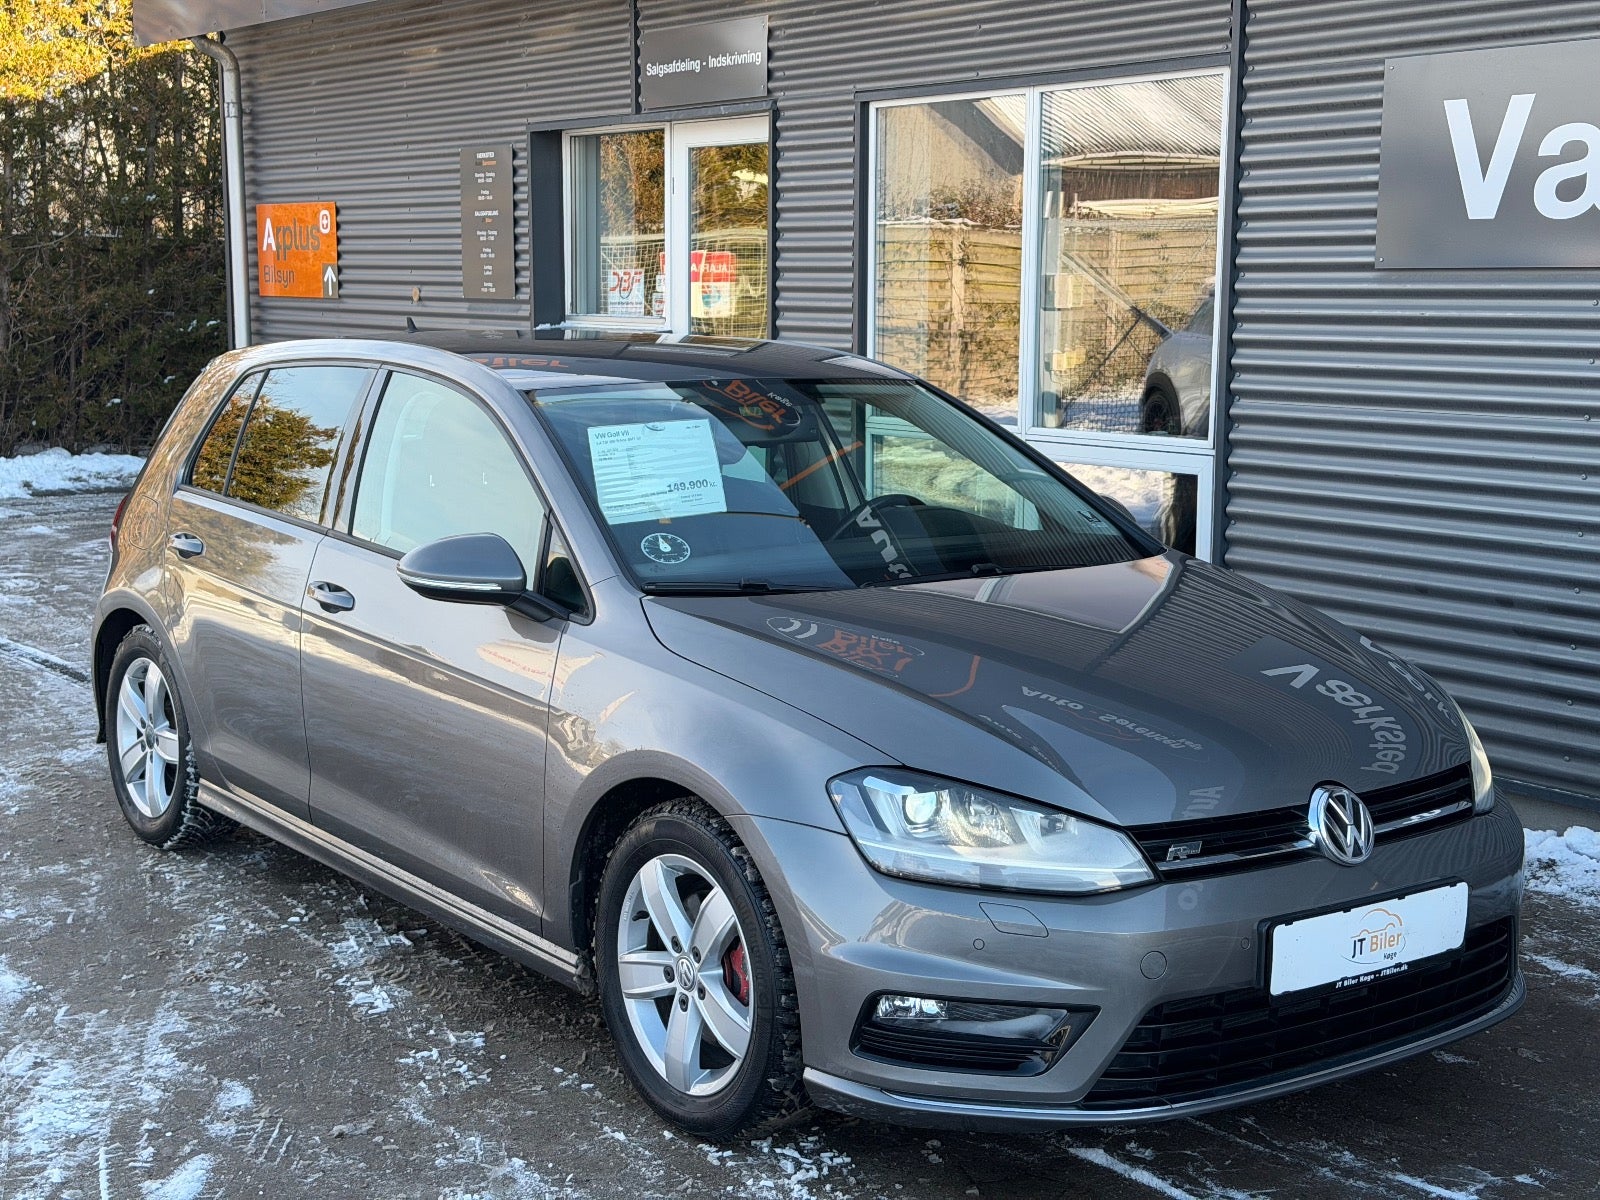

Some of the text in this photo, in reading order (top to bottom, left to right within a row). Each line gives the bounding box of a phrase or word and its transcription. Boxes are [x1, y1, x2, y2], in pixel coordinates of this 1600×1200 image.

[646, 58, 701, 77] Salgsafdeling
[708, 50, 762, 69] Indskrivning
[264, 264, 295, 288] Bilsyn
[666, 478, 709, 493] 149.900
[1351, 932, 1402, 959] JT Biler
[1335, 981, 1343, 989] JT
[1343, 978, 1359, 987] Biler
